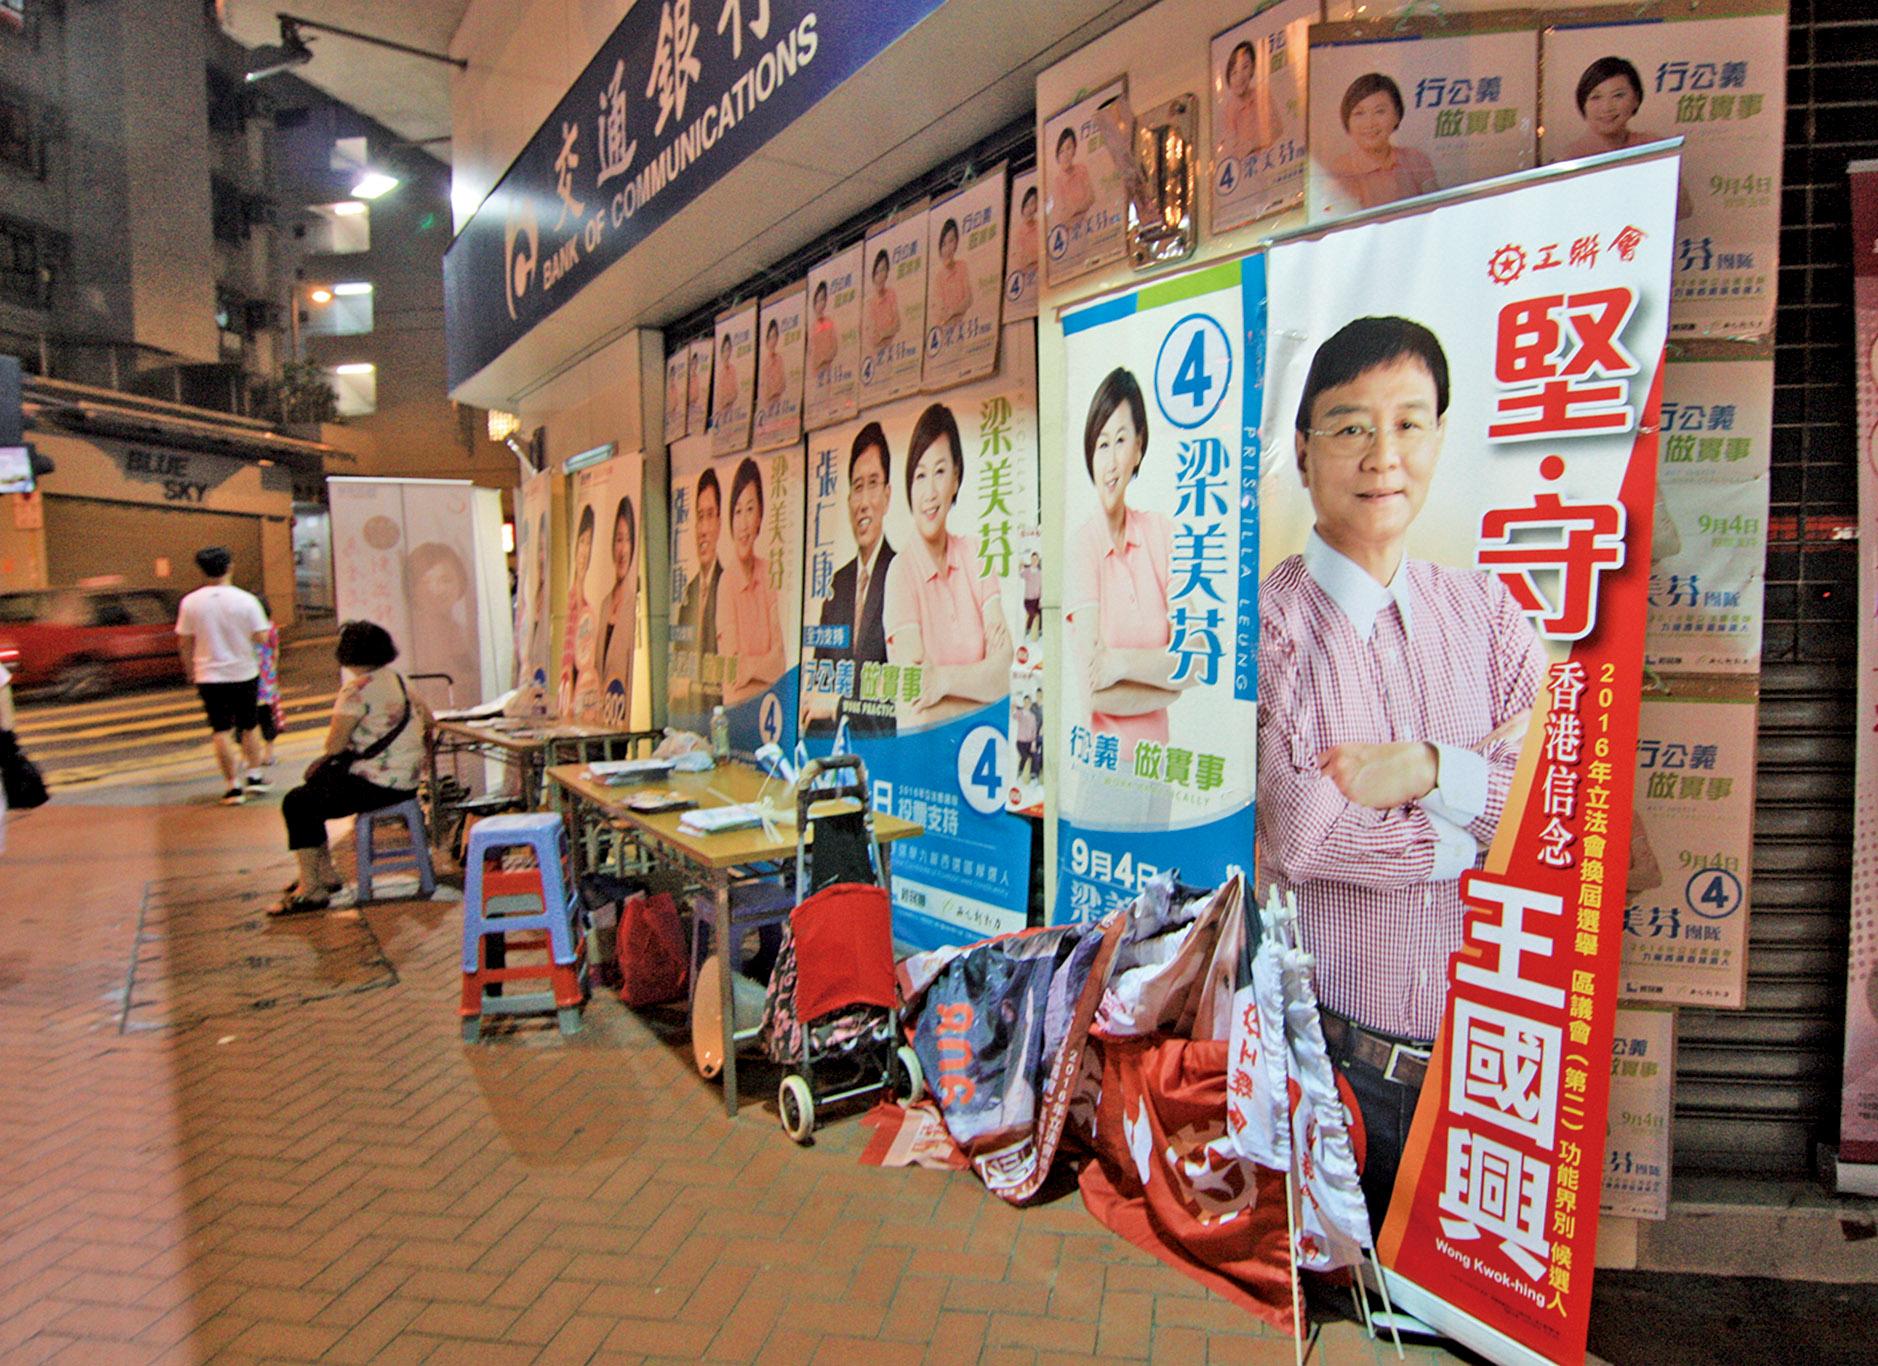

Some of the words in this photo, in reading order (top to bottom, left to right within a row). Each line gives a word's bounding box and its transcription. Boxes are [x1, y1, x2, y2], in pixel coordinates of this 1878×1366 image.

[542, 247, 579, 291] BANK
[584, 215, 605, 252] OF
[611, 12, 819, 228] COMMUNICATIONS
[1532, 224, 1648, 272] 工聯會
[1172, 328, 1213, 408] 4
[125, 449, 192, 478] BLUE
[164, 481, 207, 502] SKY
[978, 396, 1013, 578] 梁美芬
[1240, 426, 1257, 579] PRISCILLA
[1167, 437, 1231, 686] 梁美芬
[1236, 599, 1250, 691] LEUNG
[764, 700, 777, 741] 4
[971, 737, 1003, 800] 4
[1133, 741, 1226, 792] 做實事
[1537, 660, 1586, 869] 香港信念
[1438, 876, 1567, 1283] 王國興
[1552, 1139, 1582, 1239] 功能界別
[1436, 1237, 1471, 1269] Wong
[1473, 1258, 1546, 1308] Kwok-hing
[1546, 1241, 1574, 1319] 候選人
